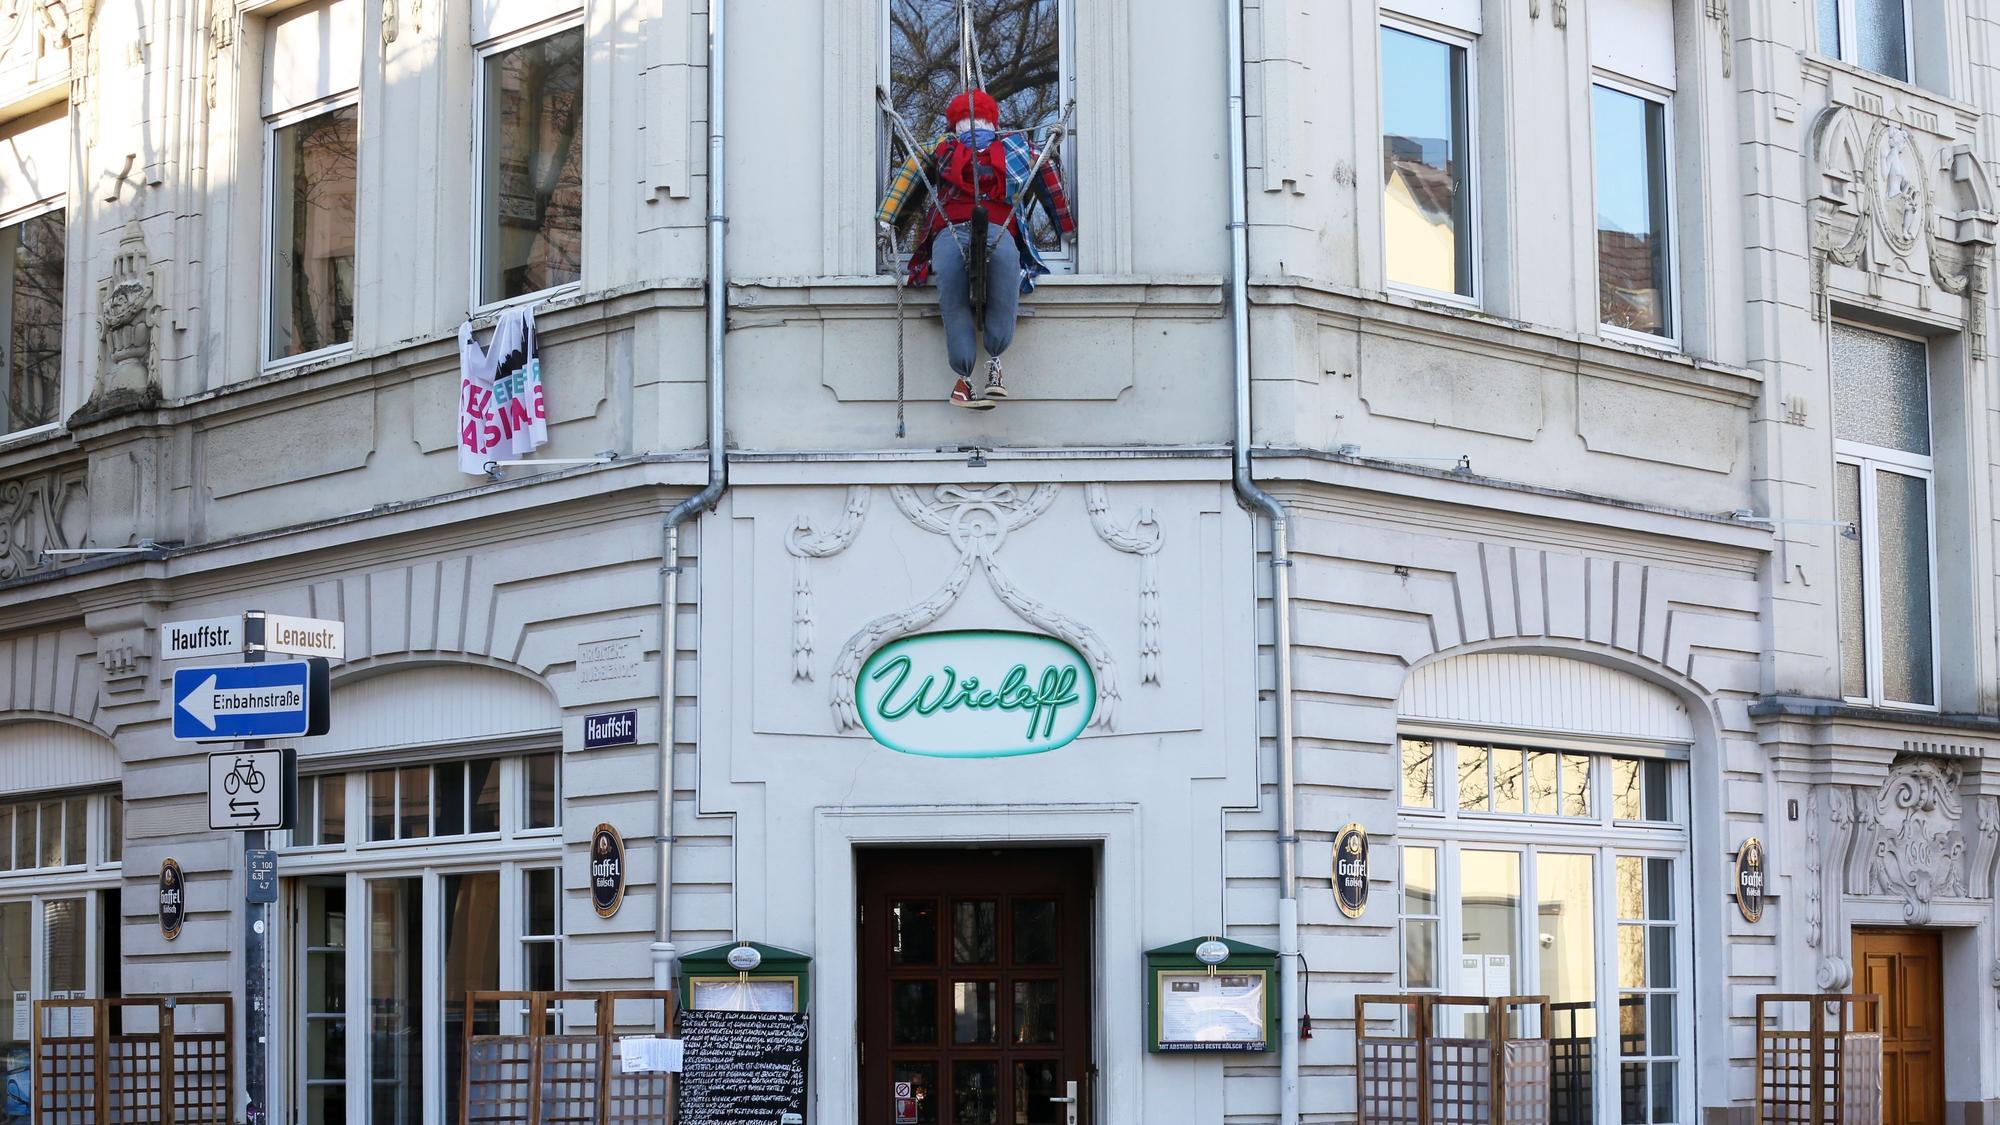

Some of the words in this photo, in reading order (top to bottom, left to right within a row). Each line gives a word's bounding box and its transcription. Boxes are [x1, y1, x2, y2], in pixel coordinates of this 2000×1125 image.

[172, 625, 232, 651] Hauffstr.
[276, 622, 336, 650] Lenaustr.
[213, 690, 300, 710] Einbahnstraße
[872, 655, 1079, 740] Wicleff
[588, 715, 632, 740] Hauffstr.
[252, 861, 257, 869] S
[262, 861, 273, 869] 100
[592, 858, 620, 877] Gaffel
[1338, 859, 1367, 877] Gaffel
[1741, 871, 1763, 887] Gaffel
[160, 889, 181, 904] Gaffel
